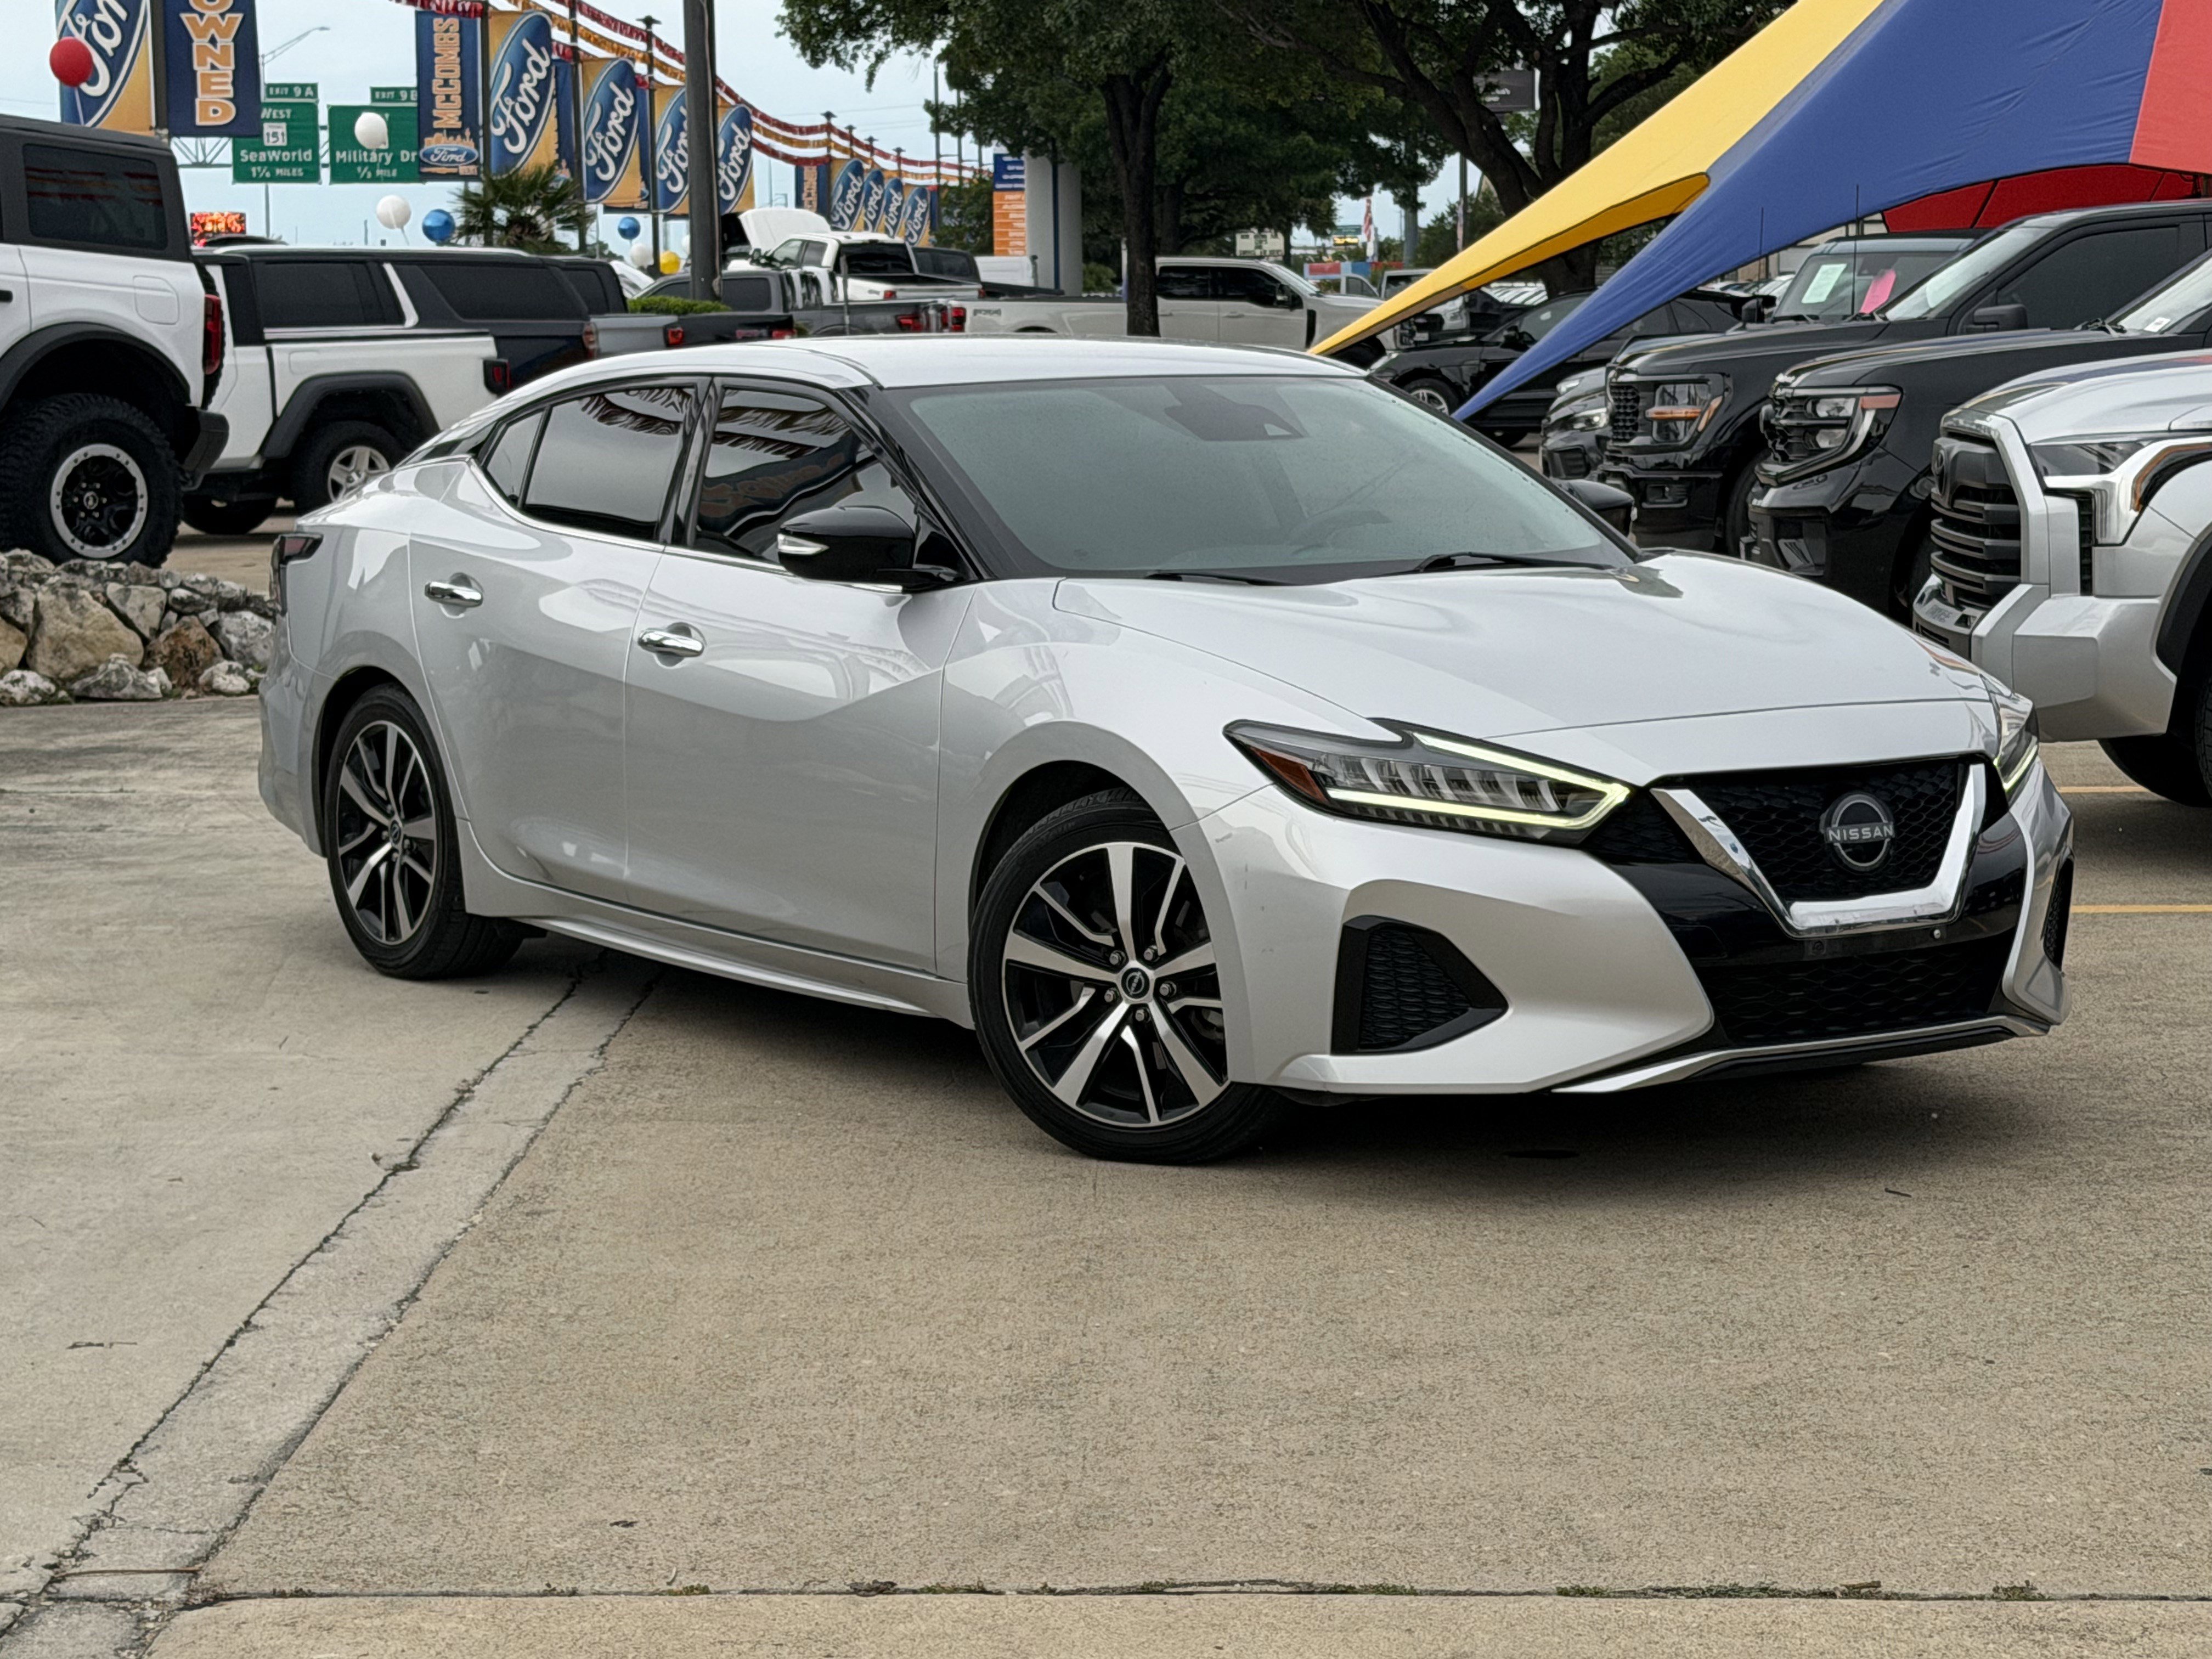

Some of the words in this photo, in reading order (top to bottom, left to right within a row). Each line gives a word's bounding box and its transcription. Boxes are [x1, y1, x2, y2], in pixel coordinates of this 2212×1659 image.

[432, 18, 462, 128] MCCOMBS
[269, 87, 289, 95] EXIT
[490, 38, 550, 154] Ford
[266, 131, 285, 144] 151
[585, 82, 634, 181] Ford
[240, 148, 313, 162] SeaWorld
[335, 149, 394, 166] Military
[400, 149, 417, 162] Dr
[430, 146, 467, 162] Ford
[831, 172, 863, 230] Ford
[906, 195, 927, 243] Ford
[1828, 825, 1893, 842] NISSAN
